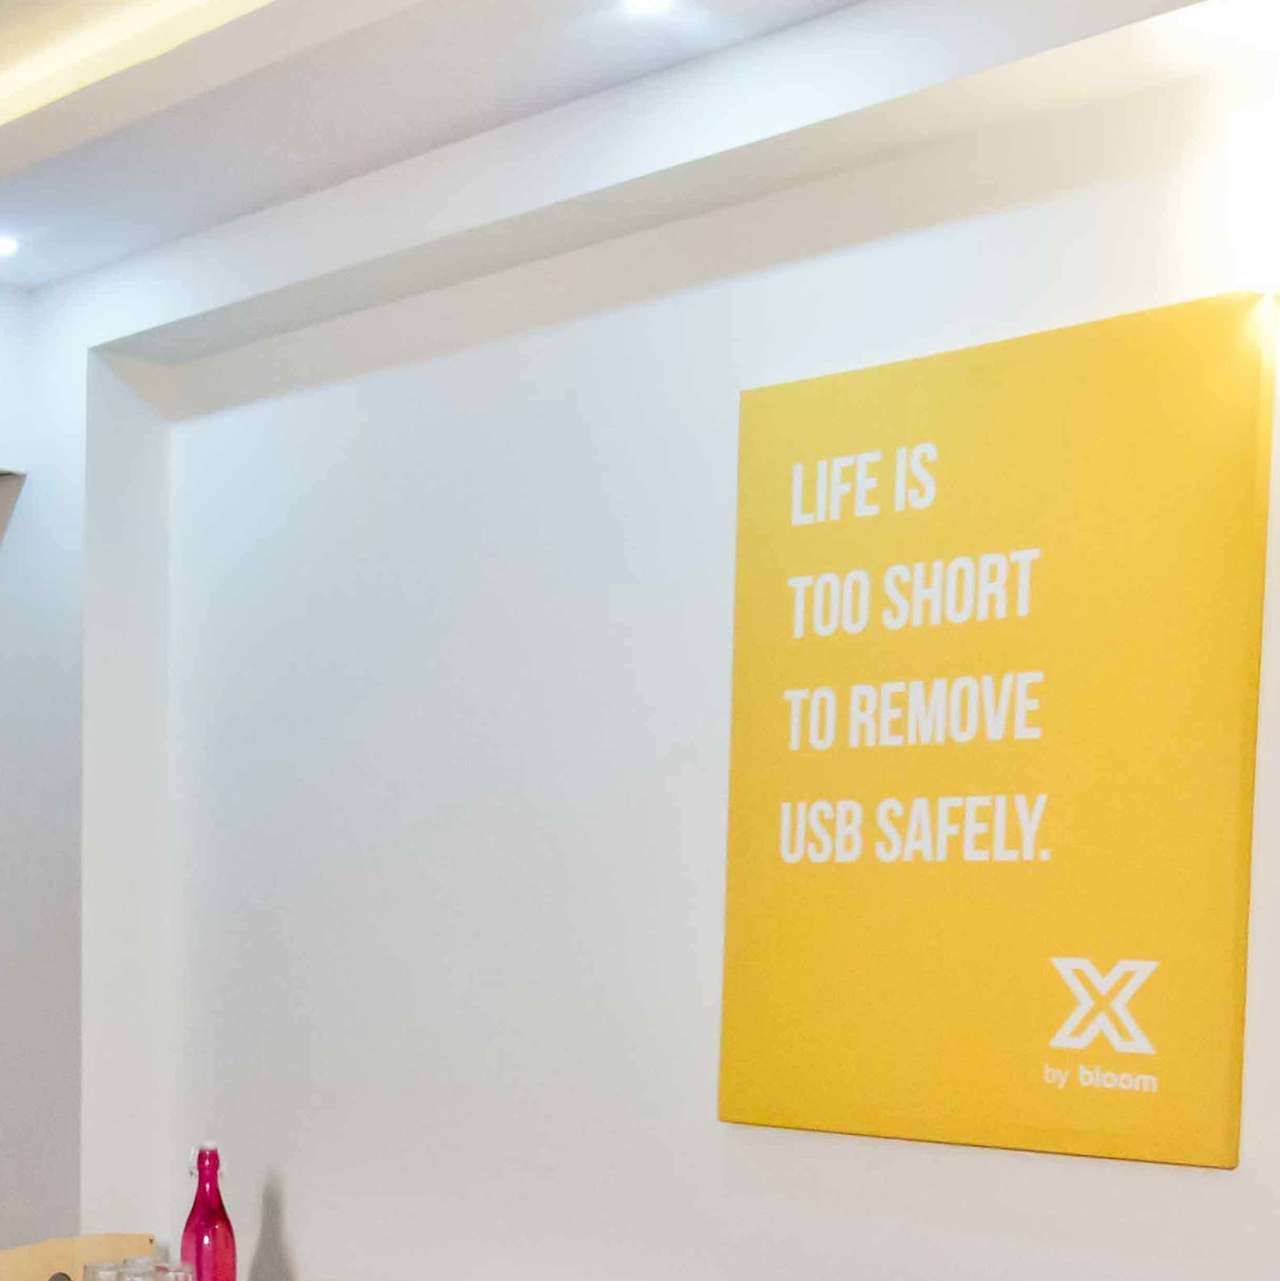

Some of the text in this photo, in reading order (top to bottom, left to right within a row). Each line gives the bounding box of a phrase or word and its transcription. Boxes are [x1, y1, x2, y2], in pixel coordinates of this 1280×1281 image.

[790, 441, 939, 527] LIFE IS
[786, 547, 1042, 639] TOO SHORT
[783, 671, 1044, 751] TO REMOVE
[780, 793, 1051, 864] USB SAFELY.
[1043, 1063, 1159, 1093] by bloom
